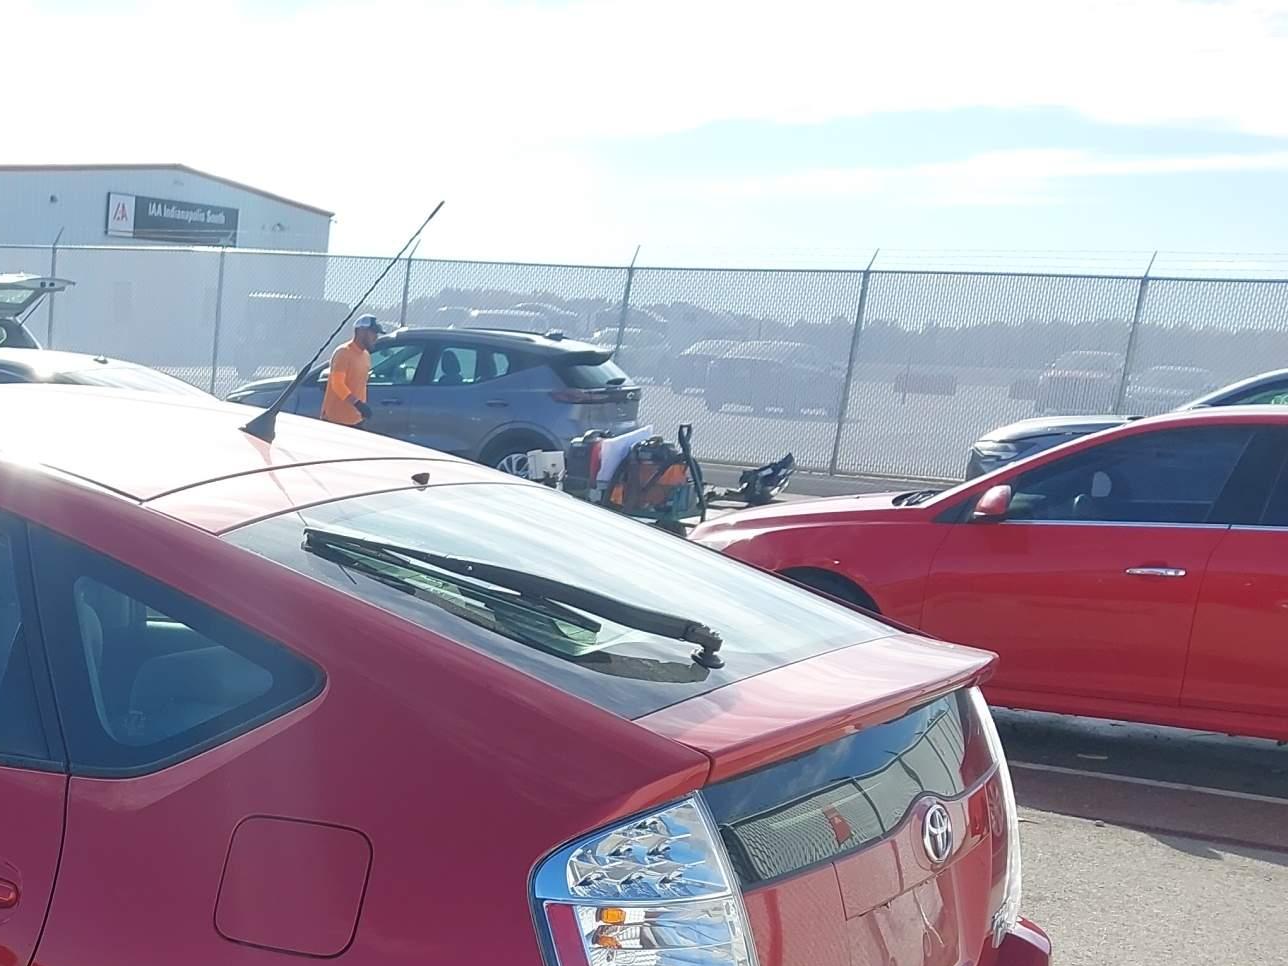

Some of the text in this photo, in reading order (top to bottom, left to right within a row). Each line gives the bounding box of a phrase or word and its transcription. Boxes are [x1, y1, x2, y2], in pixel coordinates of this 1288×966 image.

[148, 201, 226, 225] IAA Indianapolis South
